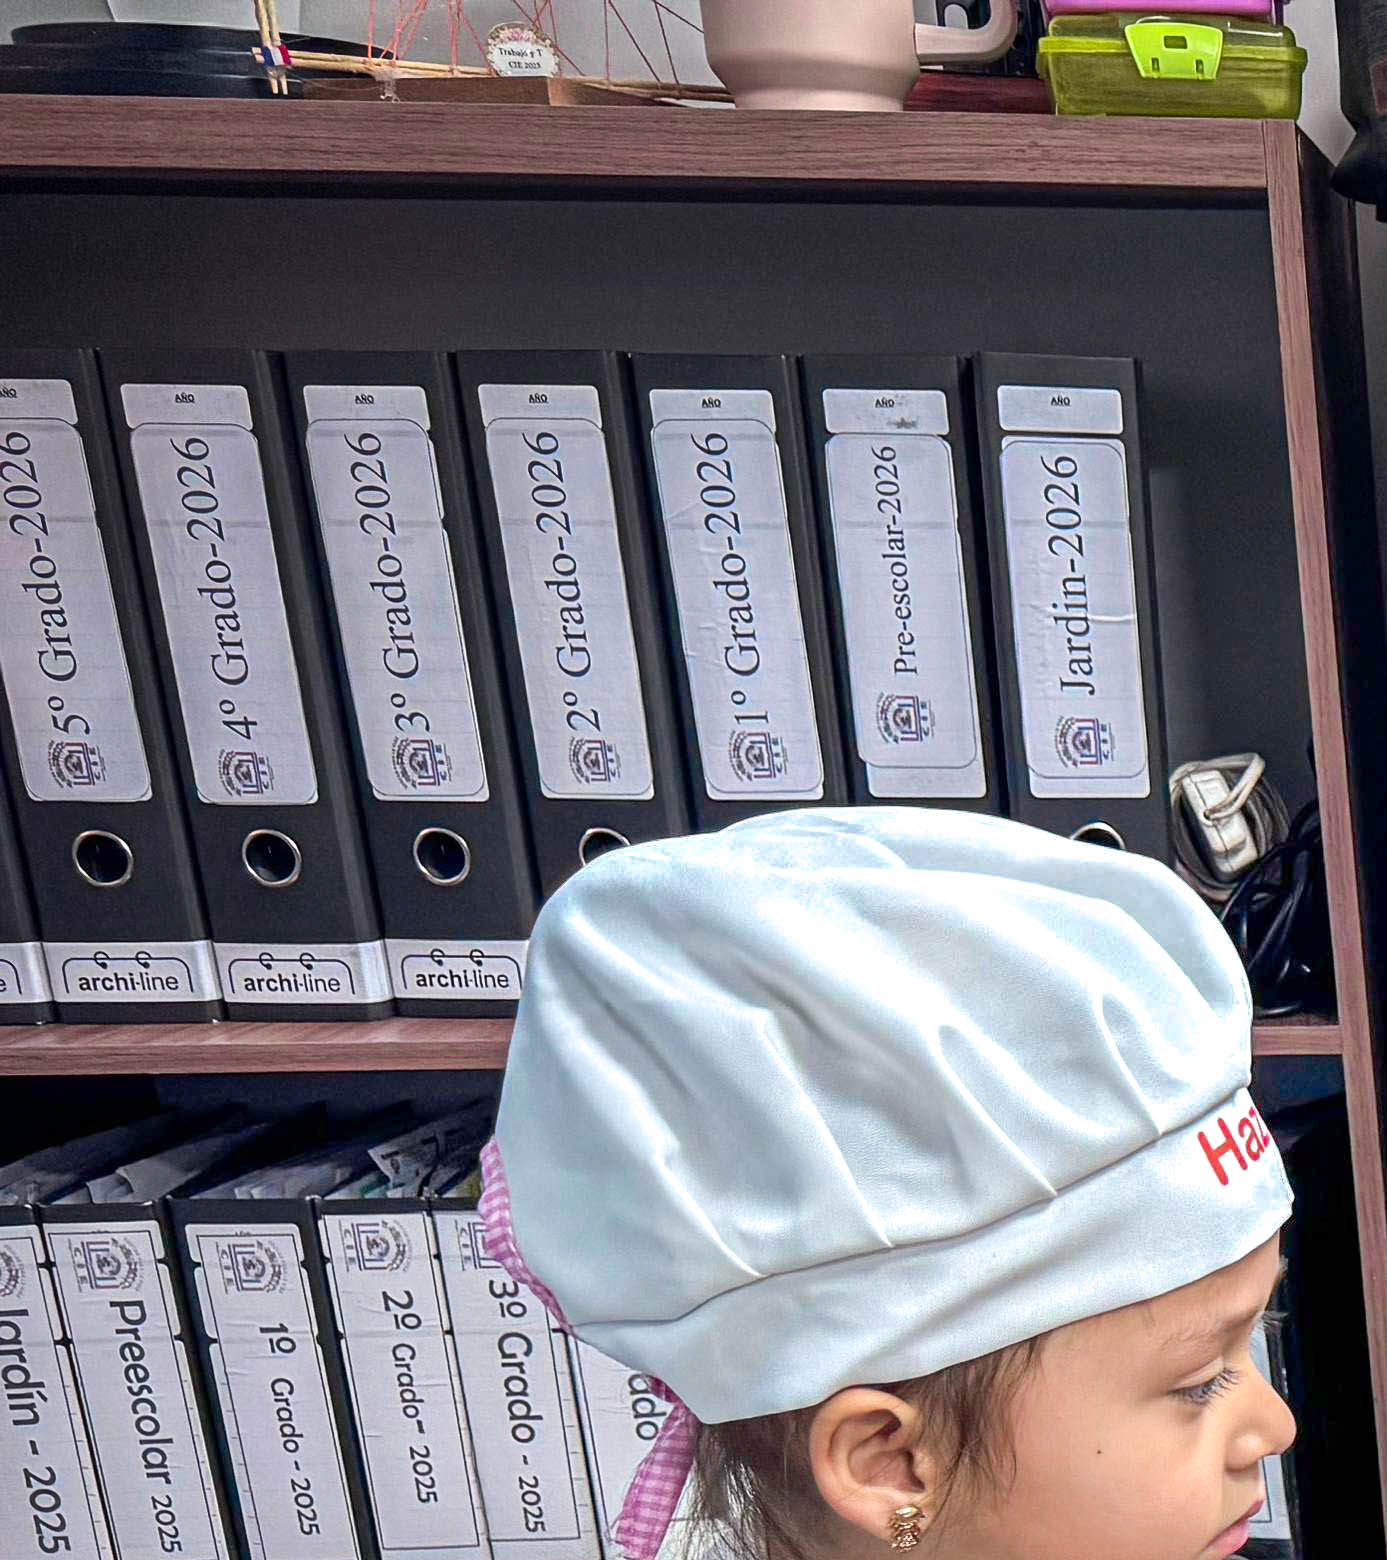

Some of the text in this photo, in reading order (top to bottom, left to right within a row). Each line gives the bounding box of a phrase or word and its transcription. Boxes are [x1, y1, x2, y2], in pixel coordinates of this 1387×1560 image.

[0, 431, 78, 679] Grado-2026
[171, 436, 248, 687] Grado-2026
[344, 431, 417, 679] Grado-2026
[522, 430, 590, 679] Grado-2026
[690, 431, 762, 678] Grado-2026
[871, 445, 920, 675] Pre-escolar-2026
[108, 1300, 183, 1553] Preescolar 2025
[270, 1377, 304, 1453] Grado
[289, 1476, 321, 1536] 2025
[409, 1445, 438, 1504] 2025
[497, 1331, 543, 1445] Grado
[517, 1475, 546, 1532] 2025
[27, 1467, 71, 1554] 2025
